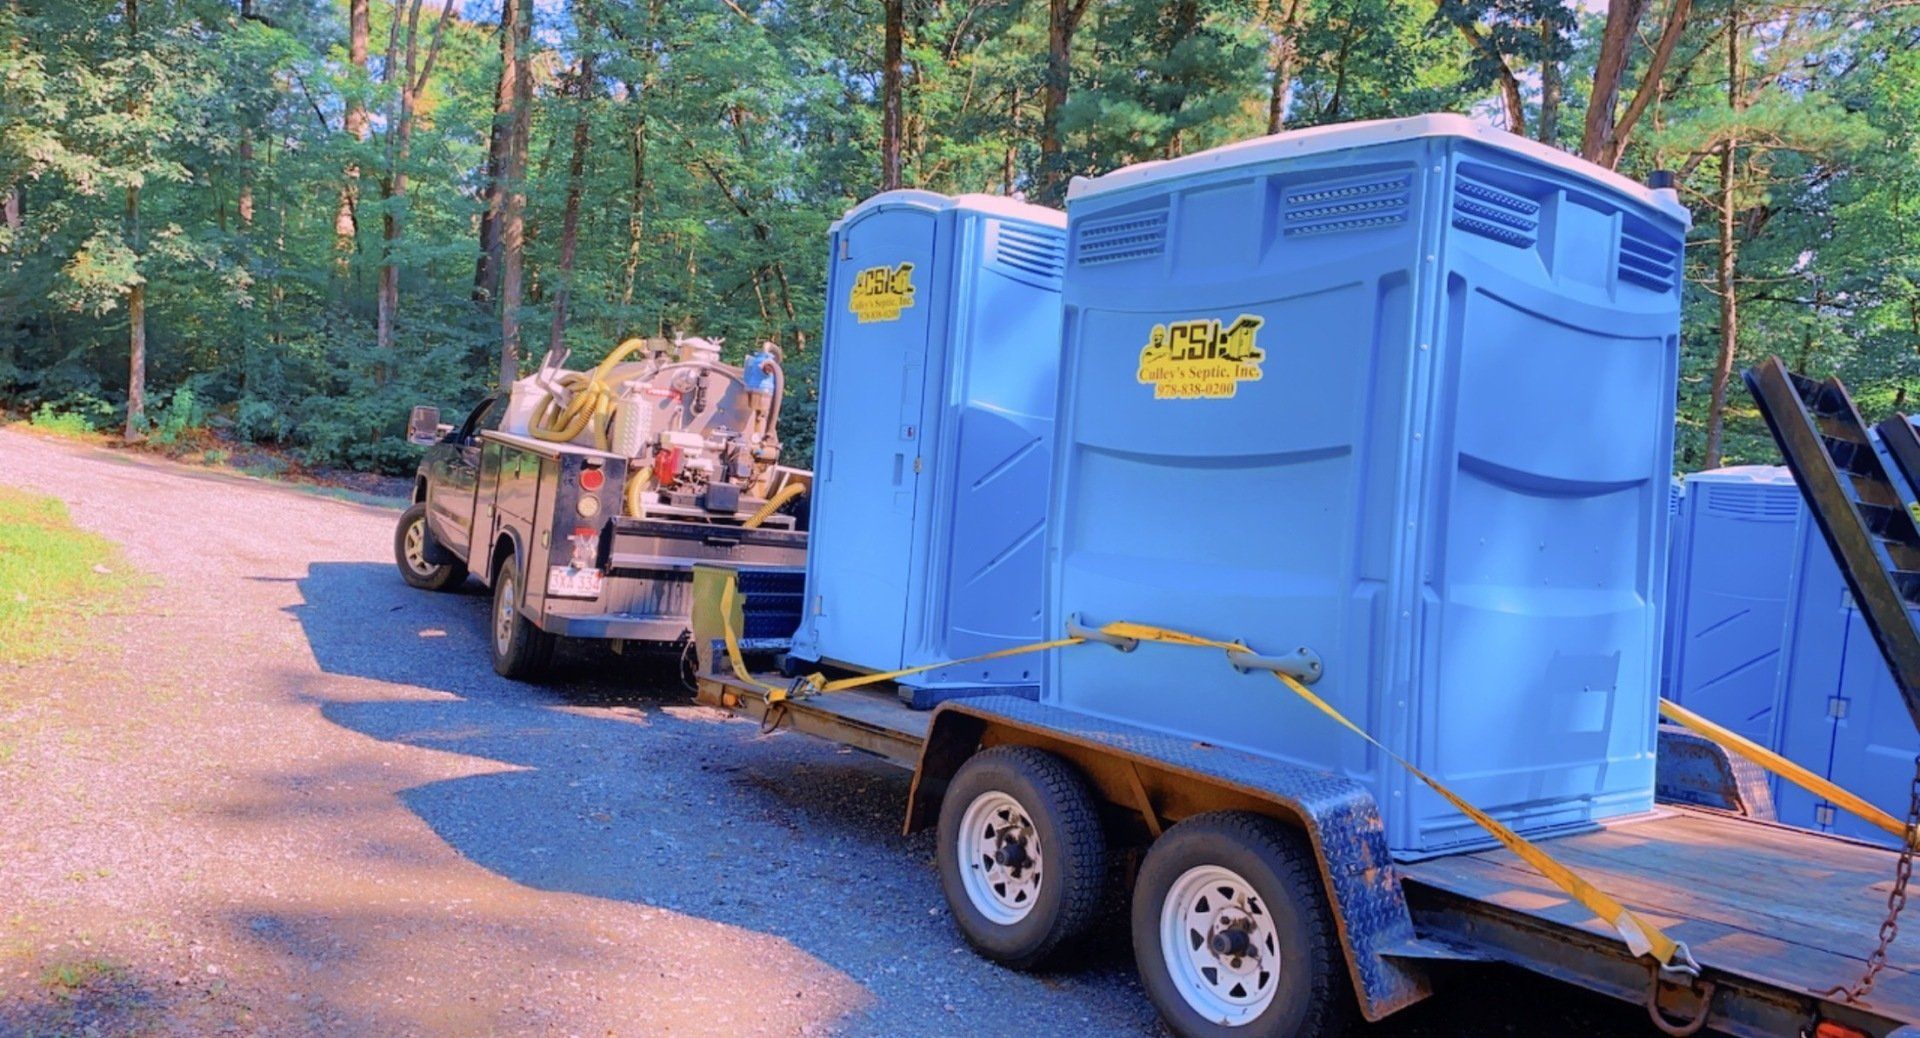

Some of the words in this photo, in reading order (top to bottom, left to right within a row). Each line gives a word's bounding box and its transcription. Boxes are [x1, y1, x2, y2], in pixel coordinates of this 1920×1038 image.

[865, 268, 890, 296] CSI
[1169, 323, 1219, 360] CSI
[1139, 366, 1185, 381] Culley's
[1235, 364, 1260, 377] Inc.
[1157, 383, 1235, 396] 978-838-0200
